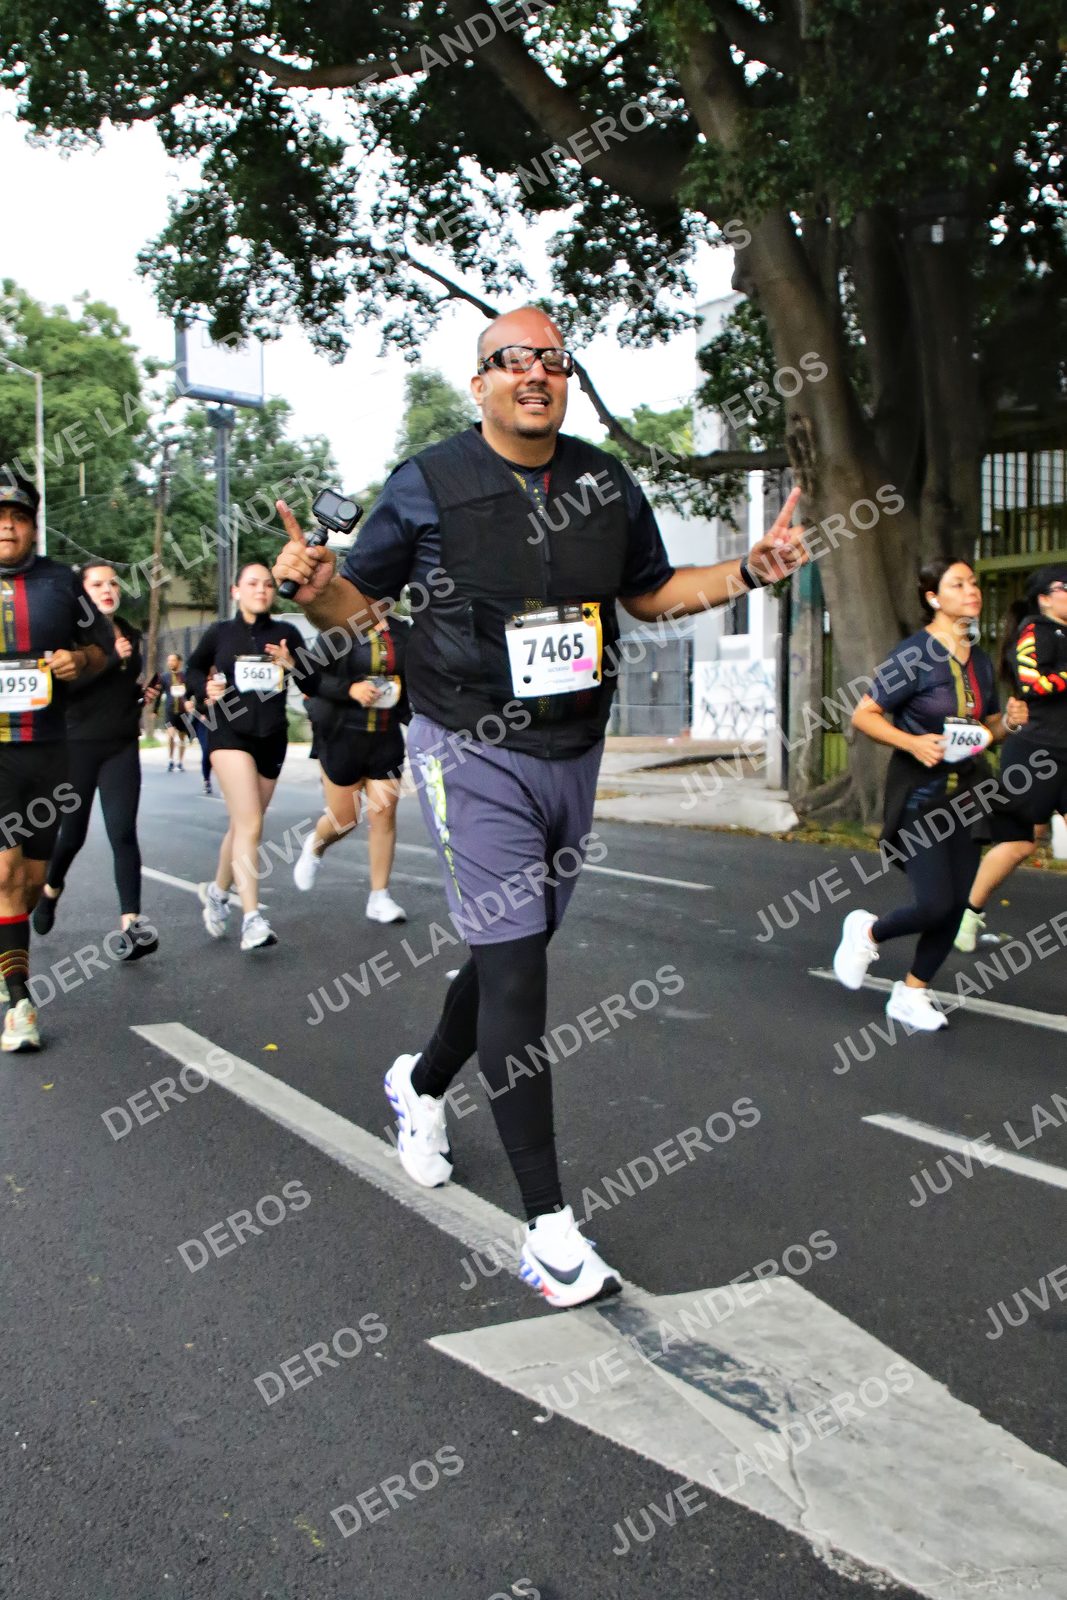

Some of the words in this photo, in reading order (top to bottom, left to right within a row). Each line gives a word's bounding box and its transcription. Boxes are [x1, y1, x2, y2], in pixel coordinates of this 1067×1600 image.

[523, 633, 584, 665] 7465
[243, 667, 272, 679] 5661
[950, 732, 982, 746] 1668
